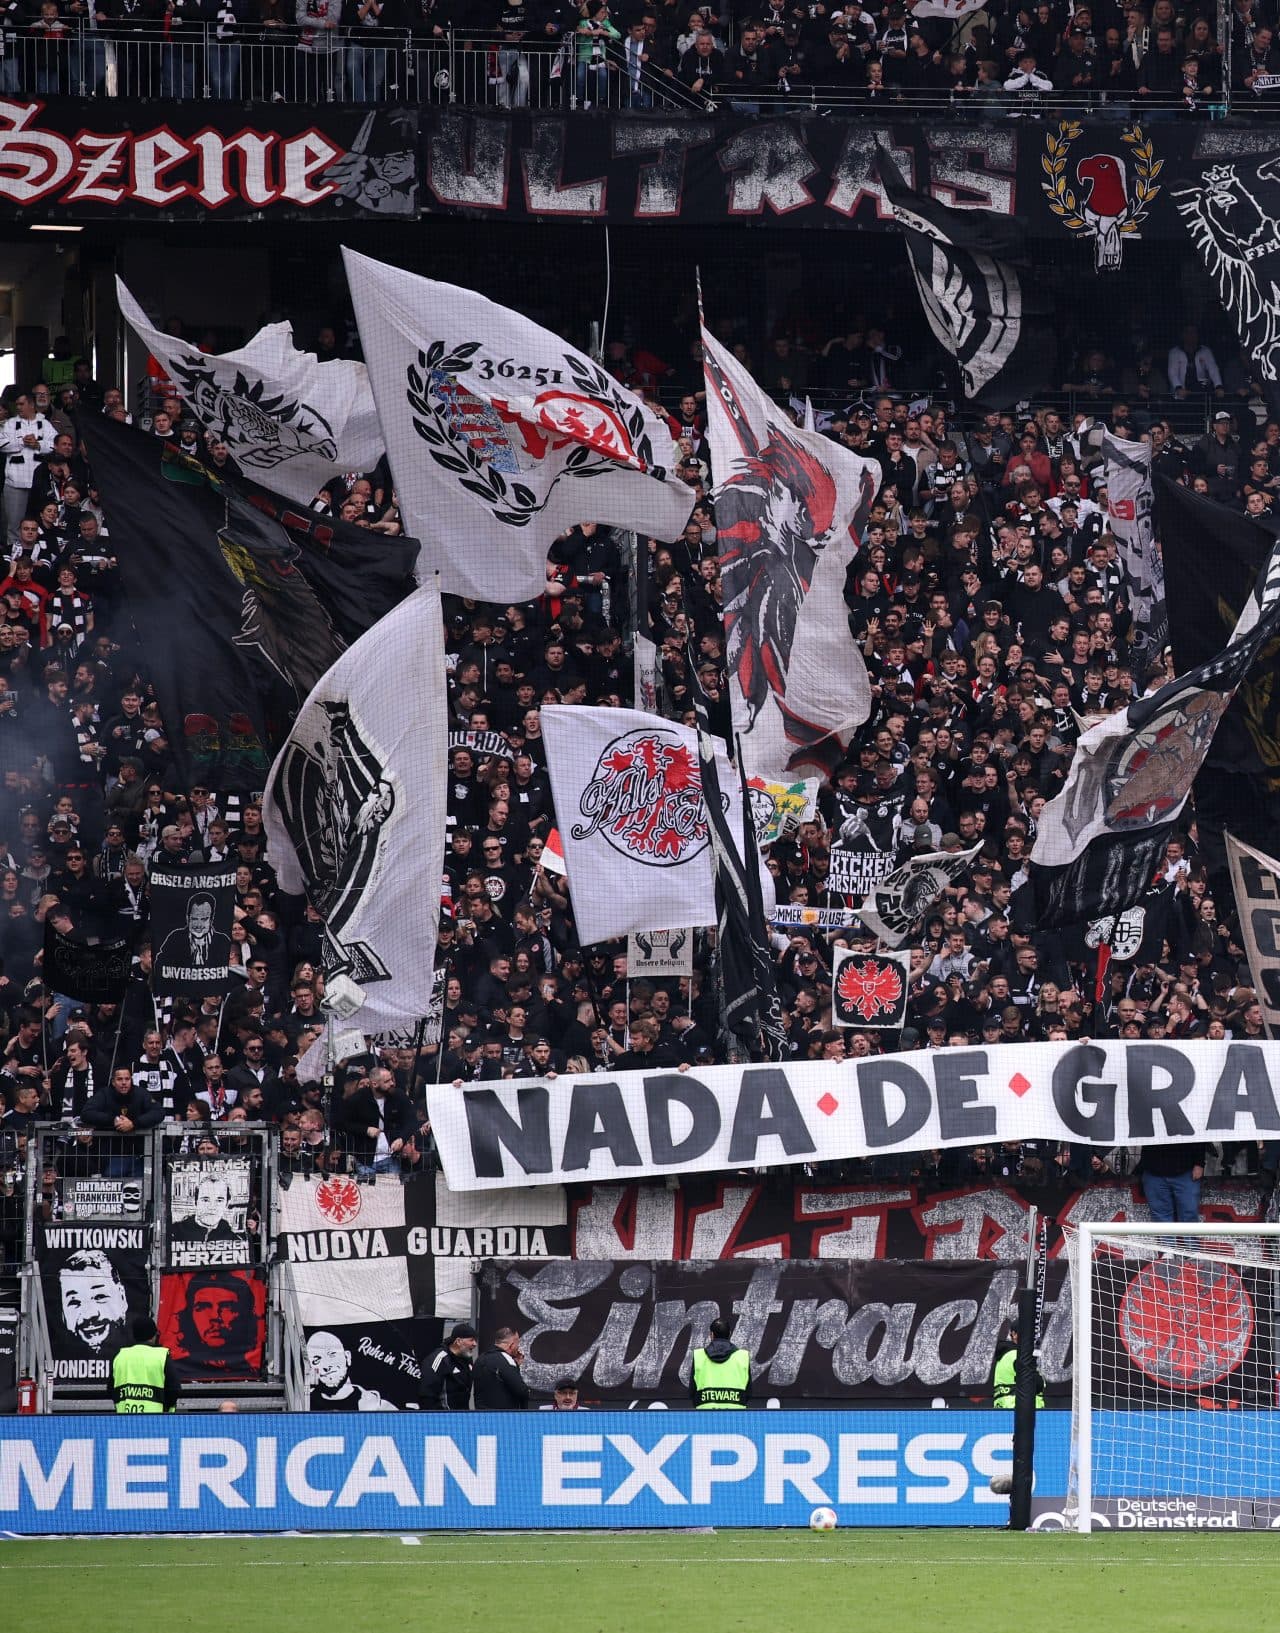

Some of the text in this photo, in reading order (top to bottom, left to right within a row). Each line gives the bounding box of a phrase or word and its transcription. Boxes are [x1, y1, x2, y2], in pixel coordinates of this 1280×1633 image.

[0, 101, 345, 208] Szene
[425, 113, 1017, 218] ULTRAS
[1245, 239, 1277, 262] FFM
[478, 355, 563, 387] 36251
[636, 959, 685, 967] Unsere Religion
[462, 1067, 817, 1177] NADA
[857, 1051, 996, 1147] DE
[75, 1181, 122, 1192] EINTRACHT
[75, 1192, 122, 1203] FRANKFURT
[75, 1203, 122, 1214] HOOLIGANS
[45, 1227, 143, 1249] WITTKOWSKI
[186, 1239, 250, 1251] UNSEREN
[286, 1226, 549, 1262] NUOVA GUARDIA
[506, 1260, 1078, 1391] Eintracht
[358, 1336, 385, 1361] Ruhe
[383, 1352, 396, 1366] in
[0, 1433, 1035, 1512] MERICAN EXPRESS
[1118, 1498, 1197, 1512] Deutsche
[1118, 1511, 1238, 1528] Dienstrad
